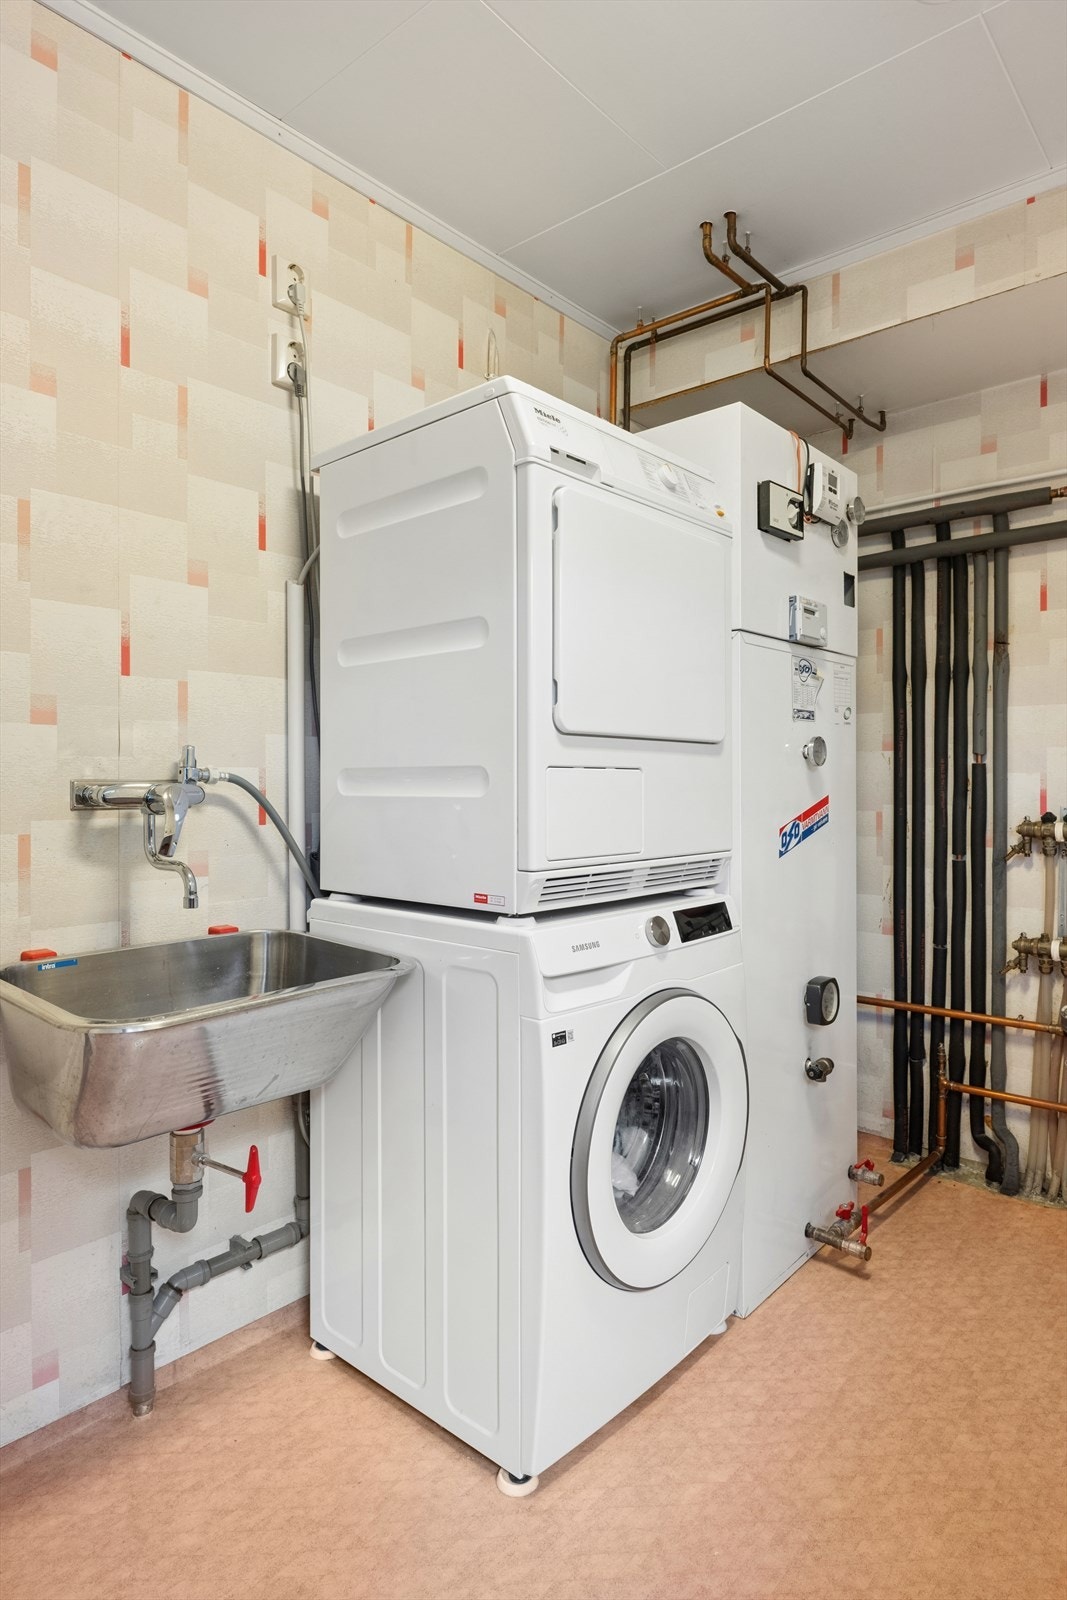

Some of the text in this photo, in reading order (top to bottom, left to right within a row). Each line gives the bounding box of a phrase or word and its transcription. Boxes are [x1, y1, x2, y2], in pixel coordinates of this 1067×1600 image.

[533, 407, 561, 424] Miele
[571, 940, 600, 953] SAMSUNG
[41, 963, 56, 971] intra
